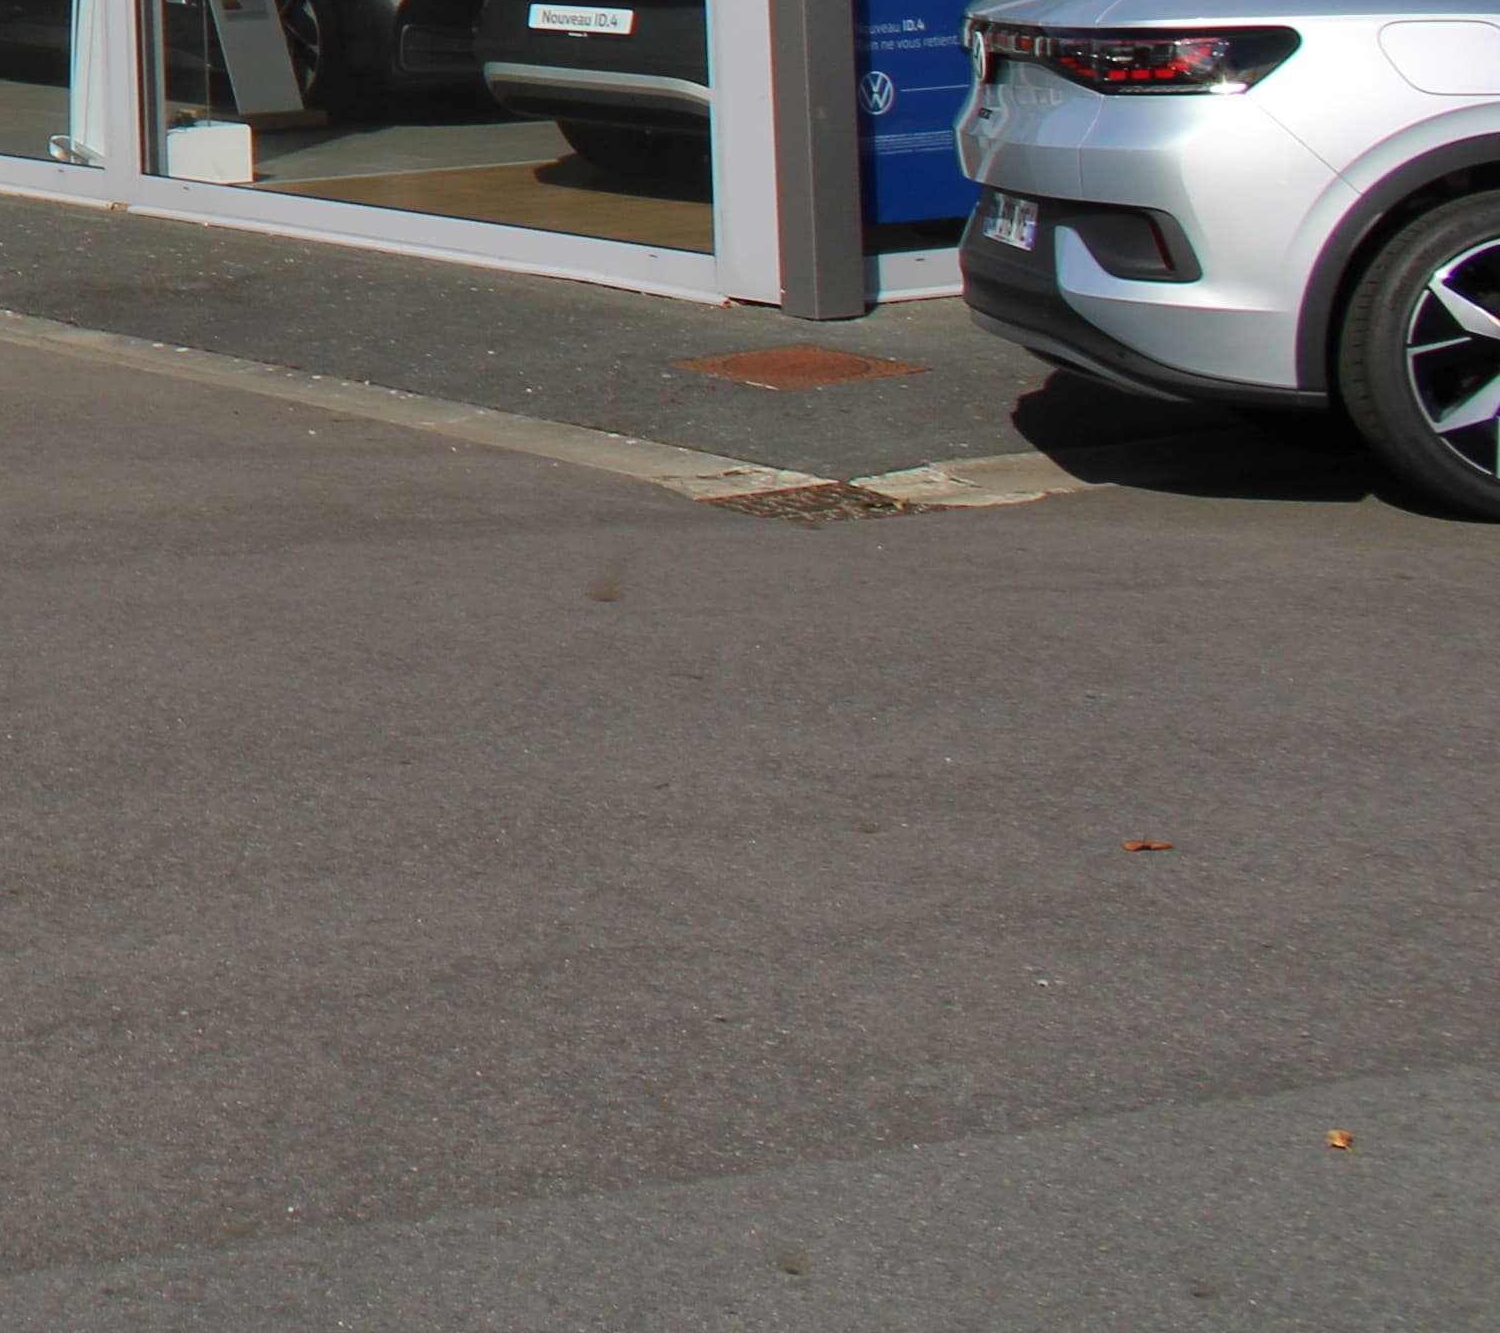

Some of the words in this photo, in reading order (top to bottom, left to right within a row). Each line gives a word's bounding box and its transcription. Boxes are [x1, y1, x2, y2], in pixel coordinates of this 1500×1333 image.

[541, 10, 591, 27] Nouveau
[594, 13, 618, 28] ID.4
[902, 18, 926, 32] ID.4
[897, 37, 920, 50] vous
